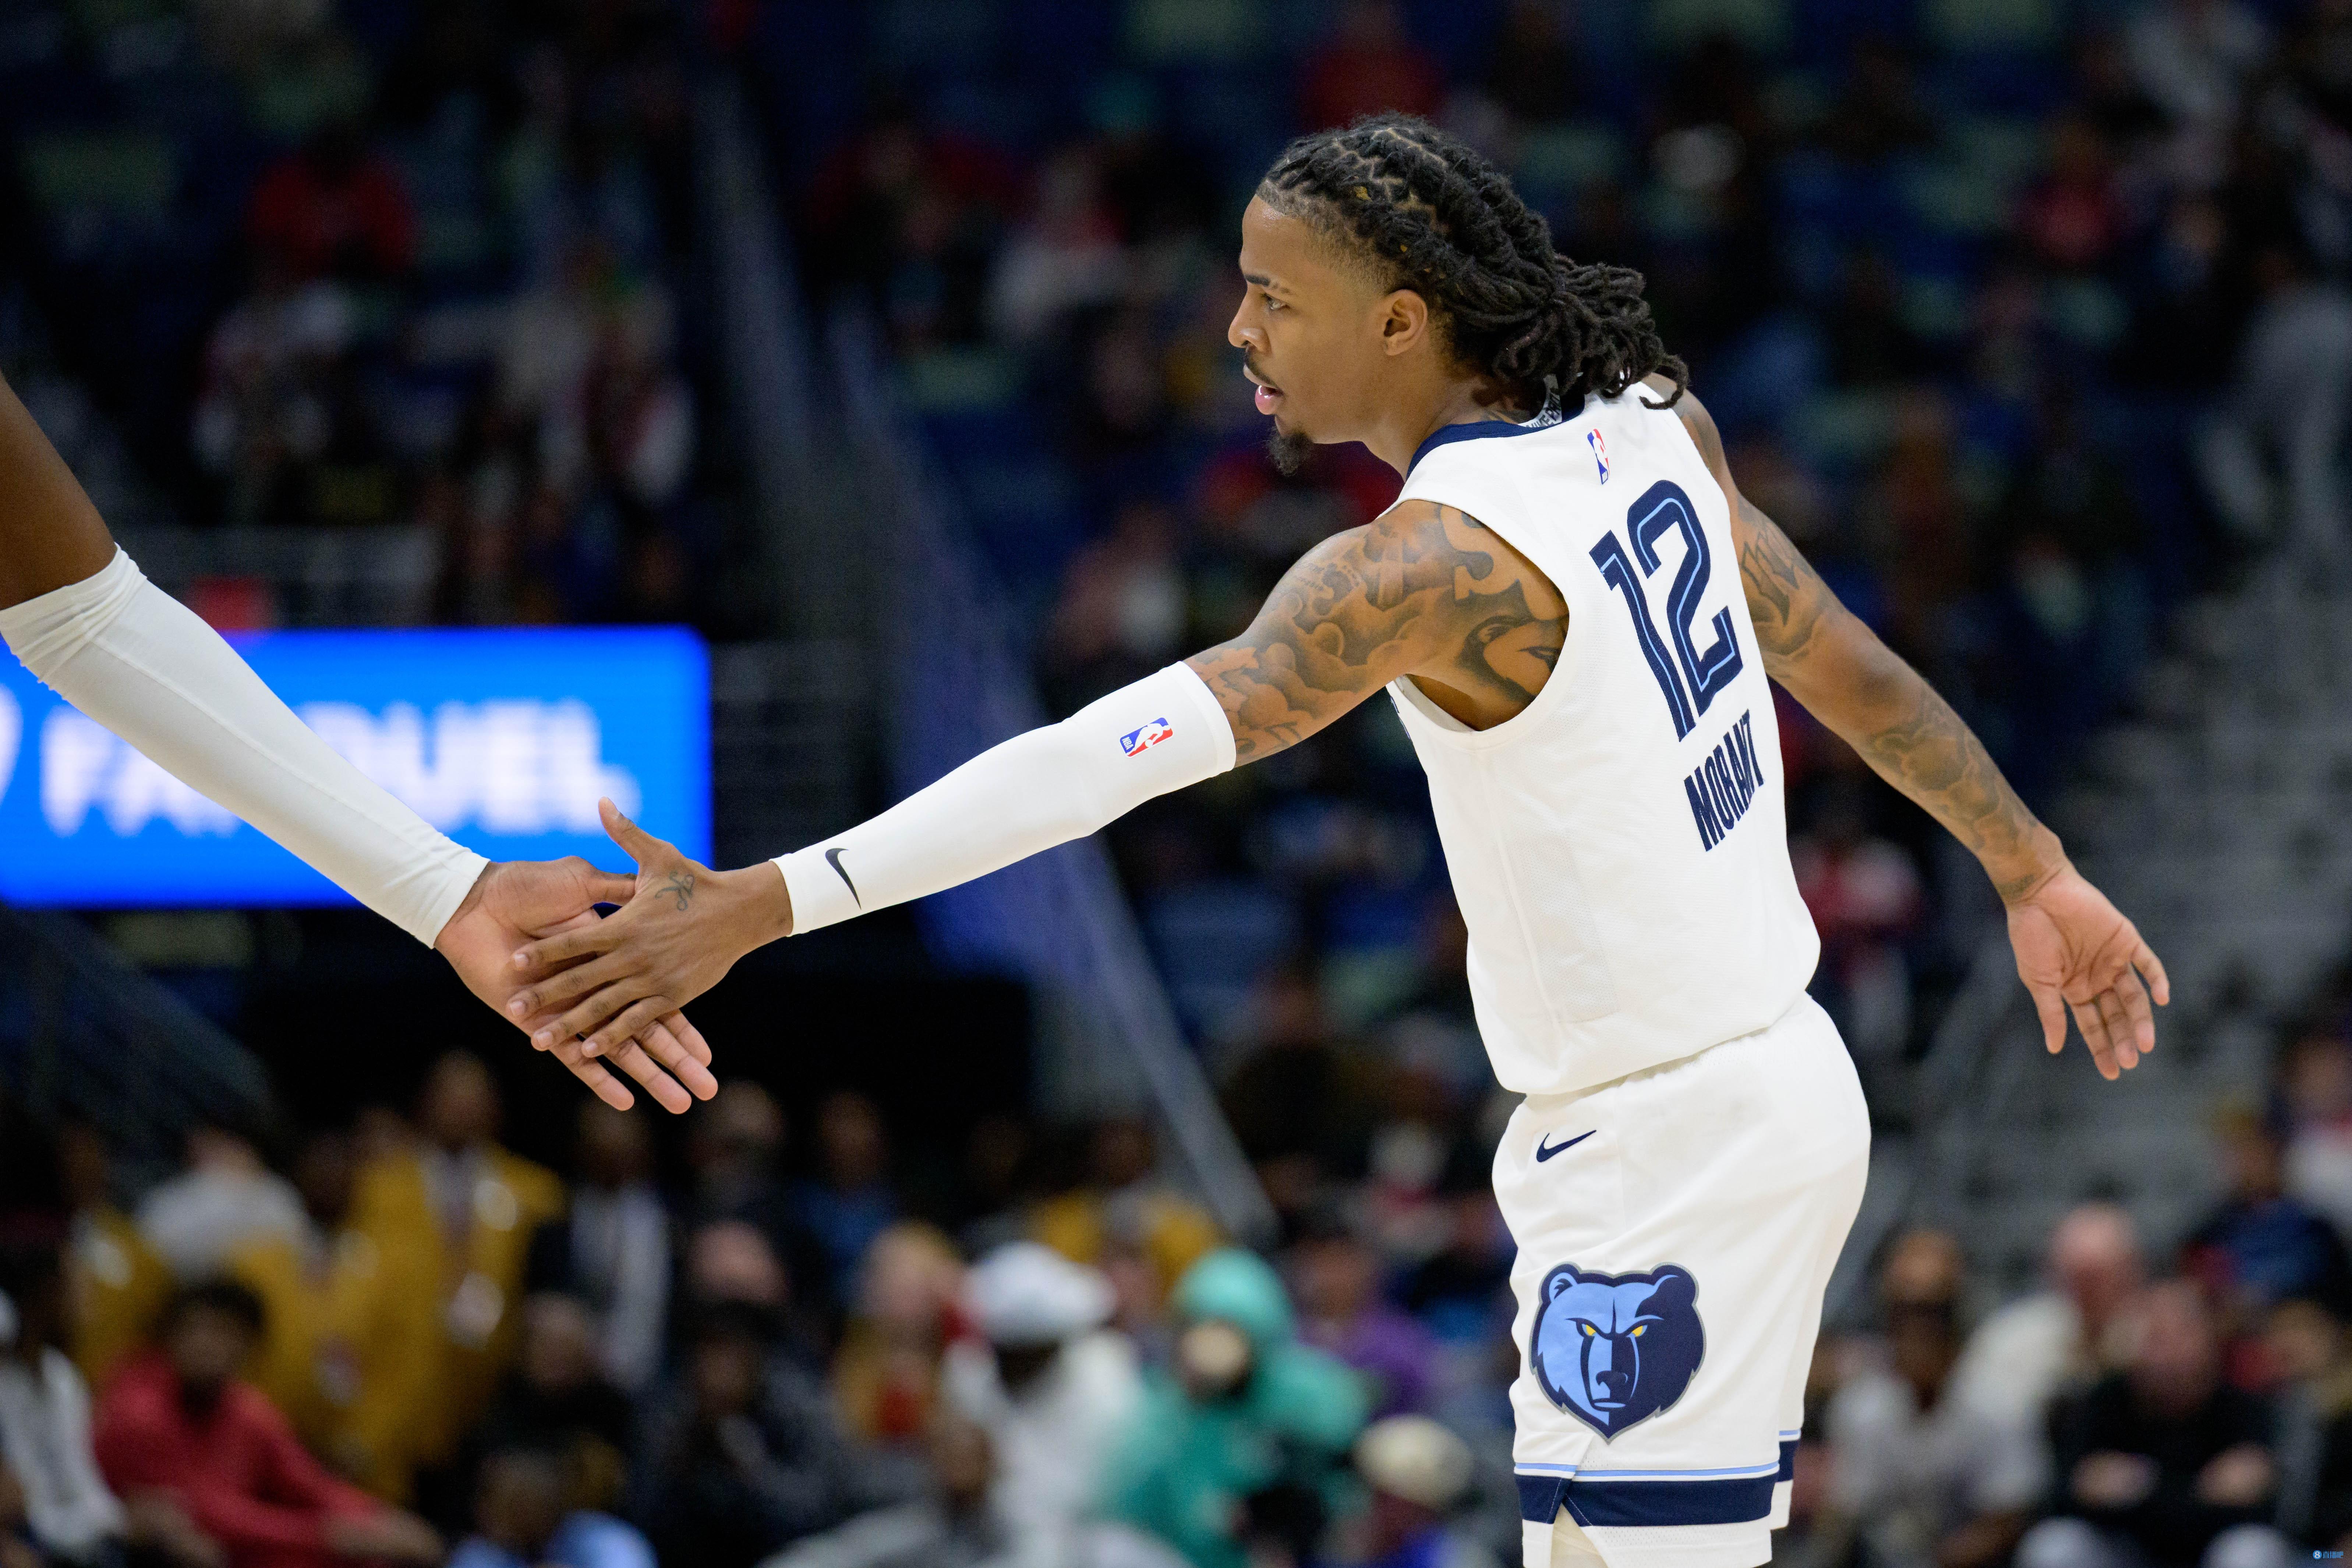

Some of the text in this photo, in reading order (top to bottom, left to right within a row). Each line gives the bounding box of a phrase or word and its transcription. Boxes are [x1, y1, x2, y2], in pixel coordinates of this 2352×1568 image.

[1589, 479, 1743, 742] 12
[42, 700, 637, 832] FAUEL
[1122, 736, 1134, 750] NBA
[1684, 709, 1764, 852] MORANT
